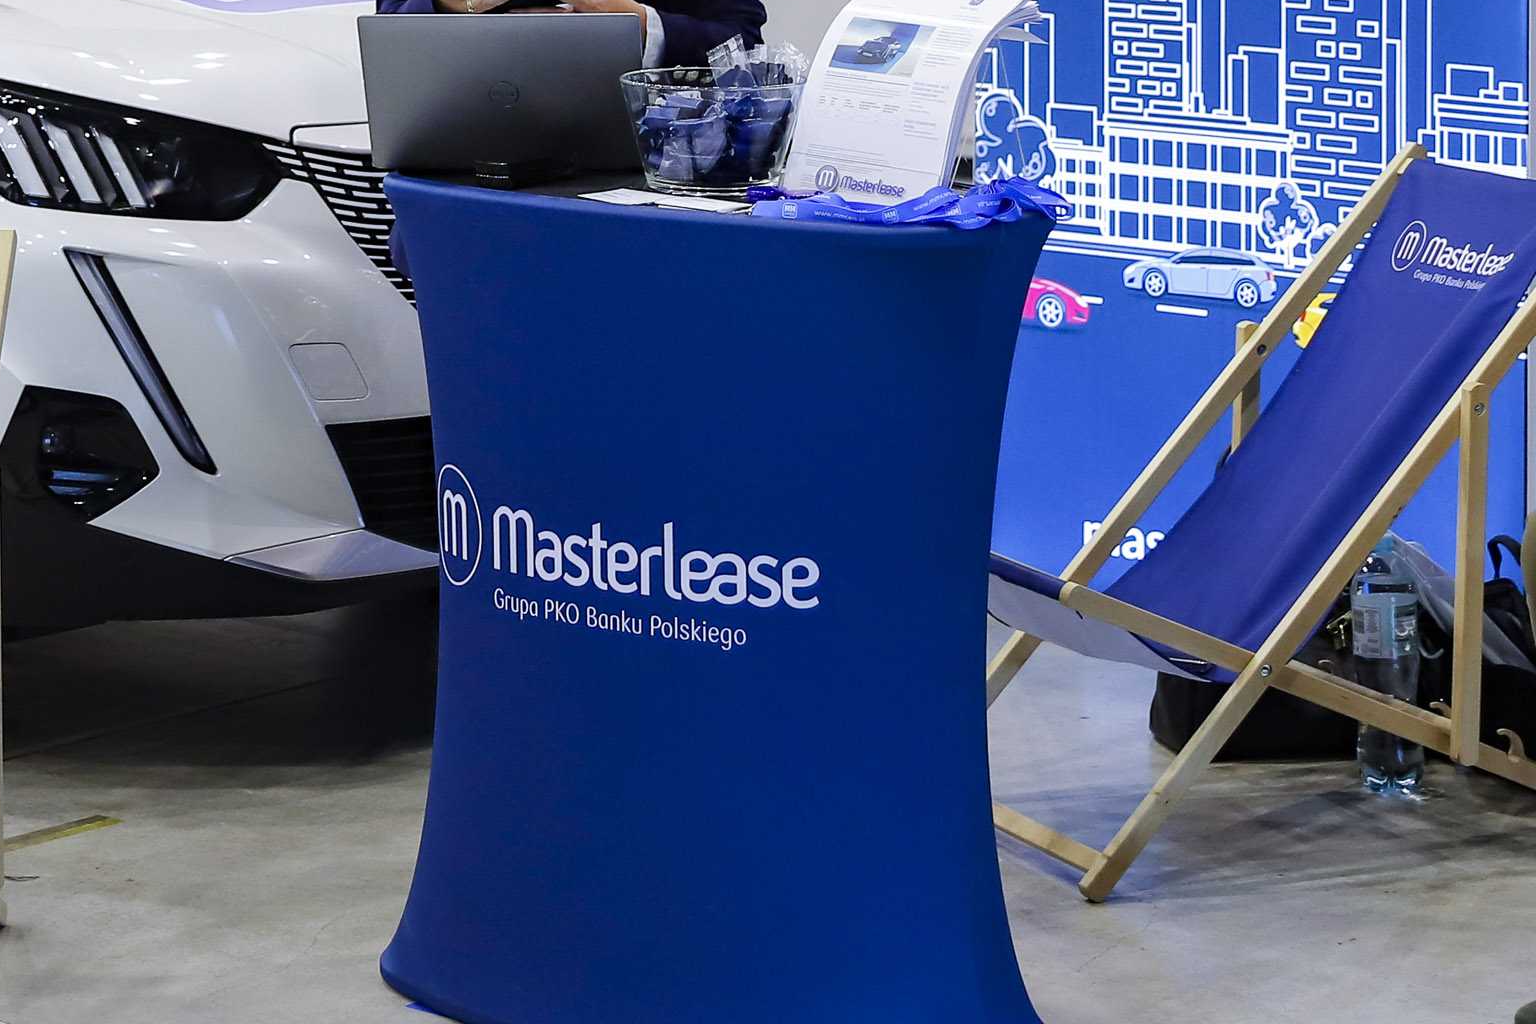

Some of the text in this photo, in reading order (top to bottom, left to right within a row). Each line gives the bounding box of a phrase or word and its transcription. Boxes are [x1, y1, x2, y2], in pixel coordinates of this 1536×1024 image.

[1420, 236, 1515, 275] Masterlea
[492, 505, 820, 610] Masterlease
[493, 588, 747, 651] Grupa PKO Banku Polskiego
